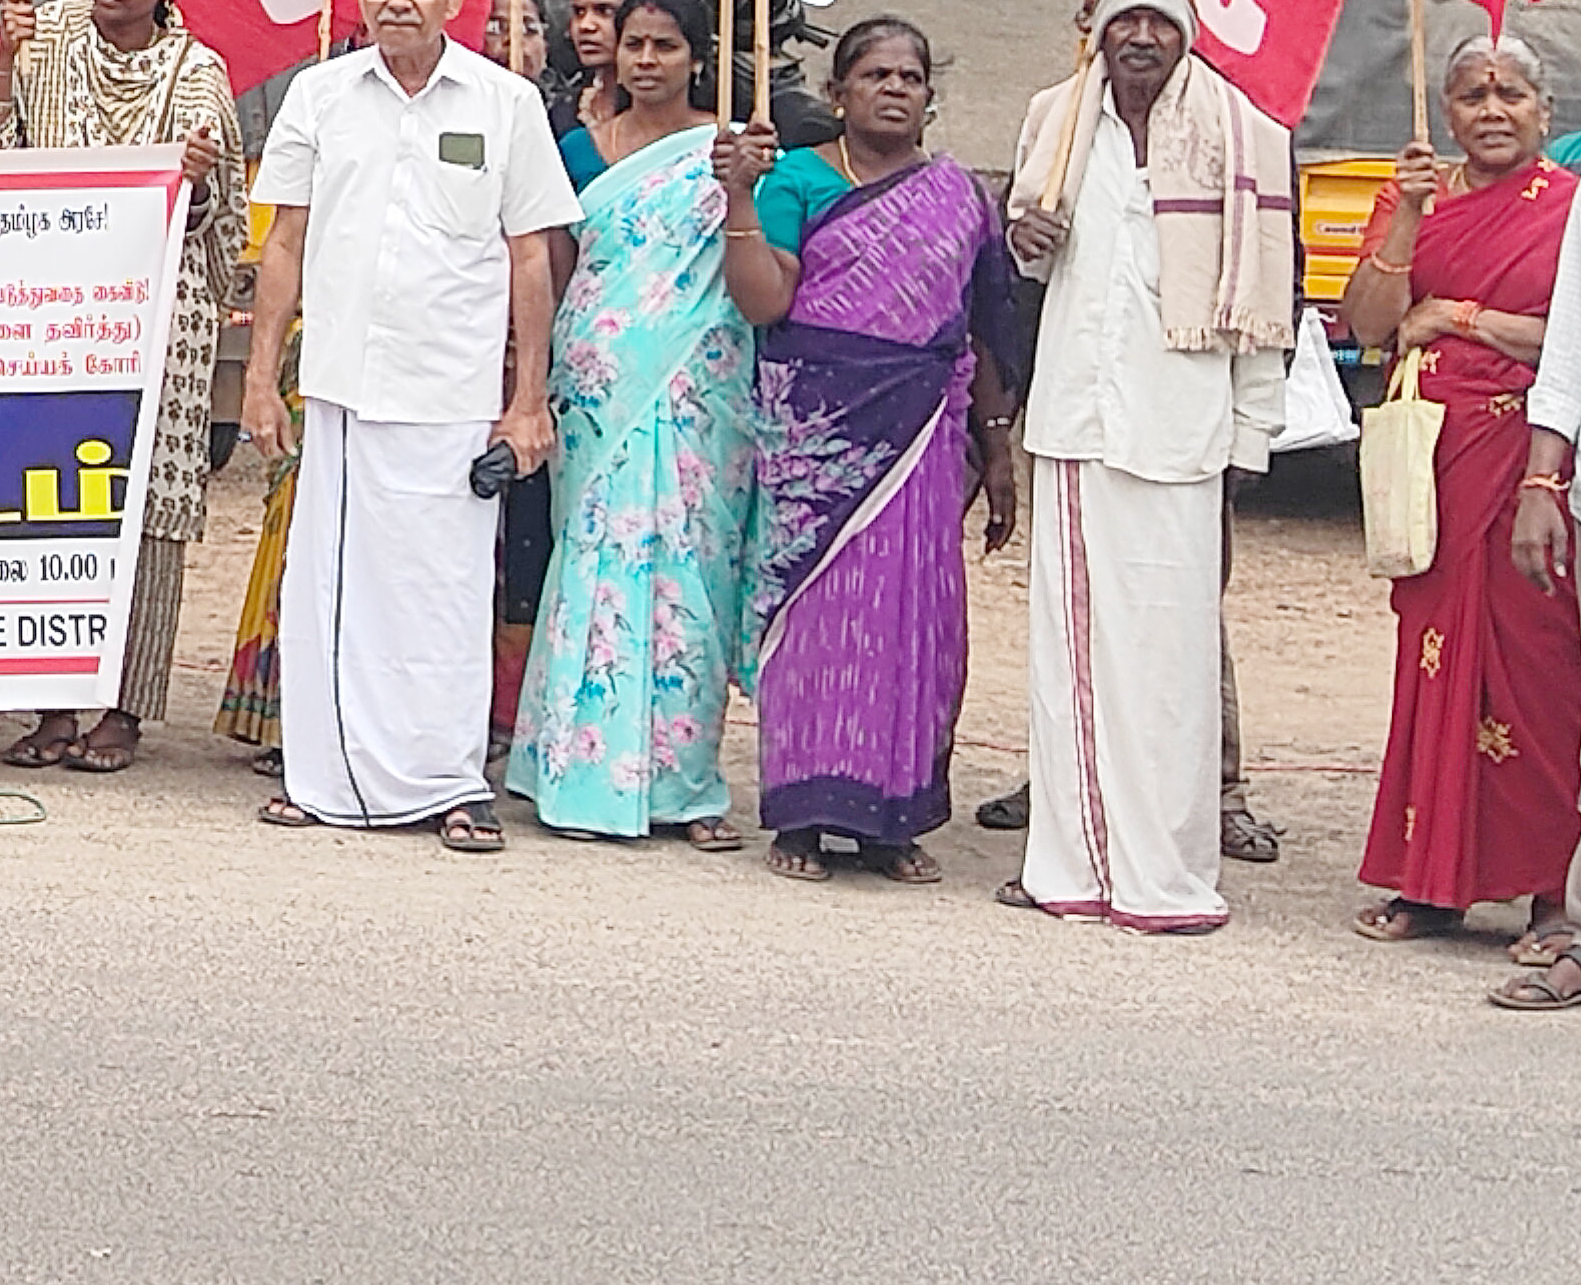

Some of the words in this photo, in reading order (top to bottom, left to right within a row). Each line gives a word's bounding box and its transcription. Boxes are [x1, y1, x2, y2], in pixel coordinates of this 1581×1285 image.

[58, 201, 109, 235] அரசே!
[84, 349, 142, 376] கோரி
[39, 554, 98, 582] 10.00
